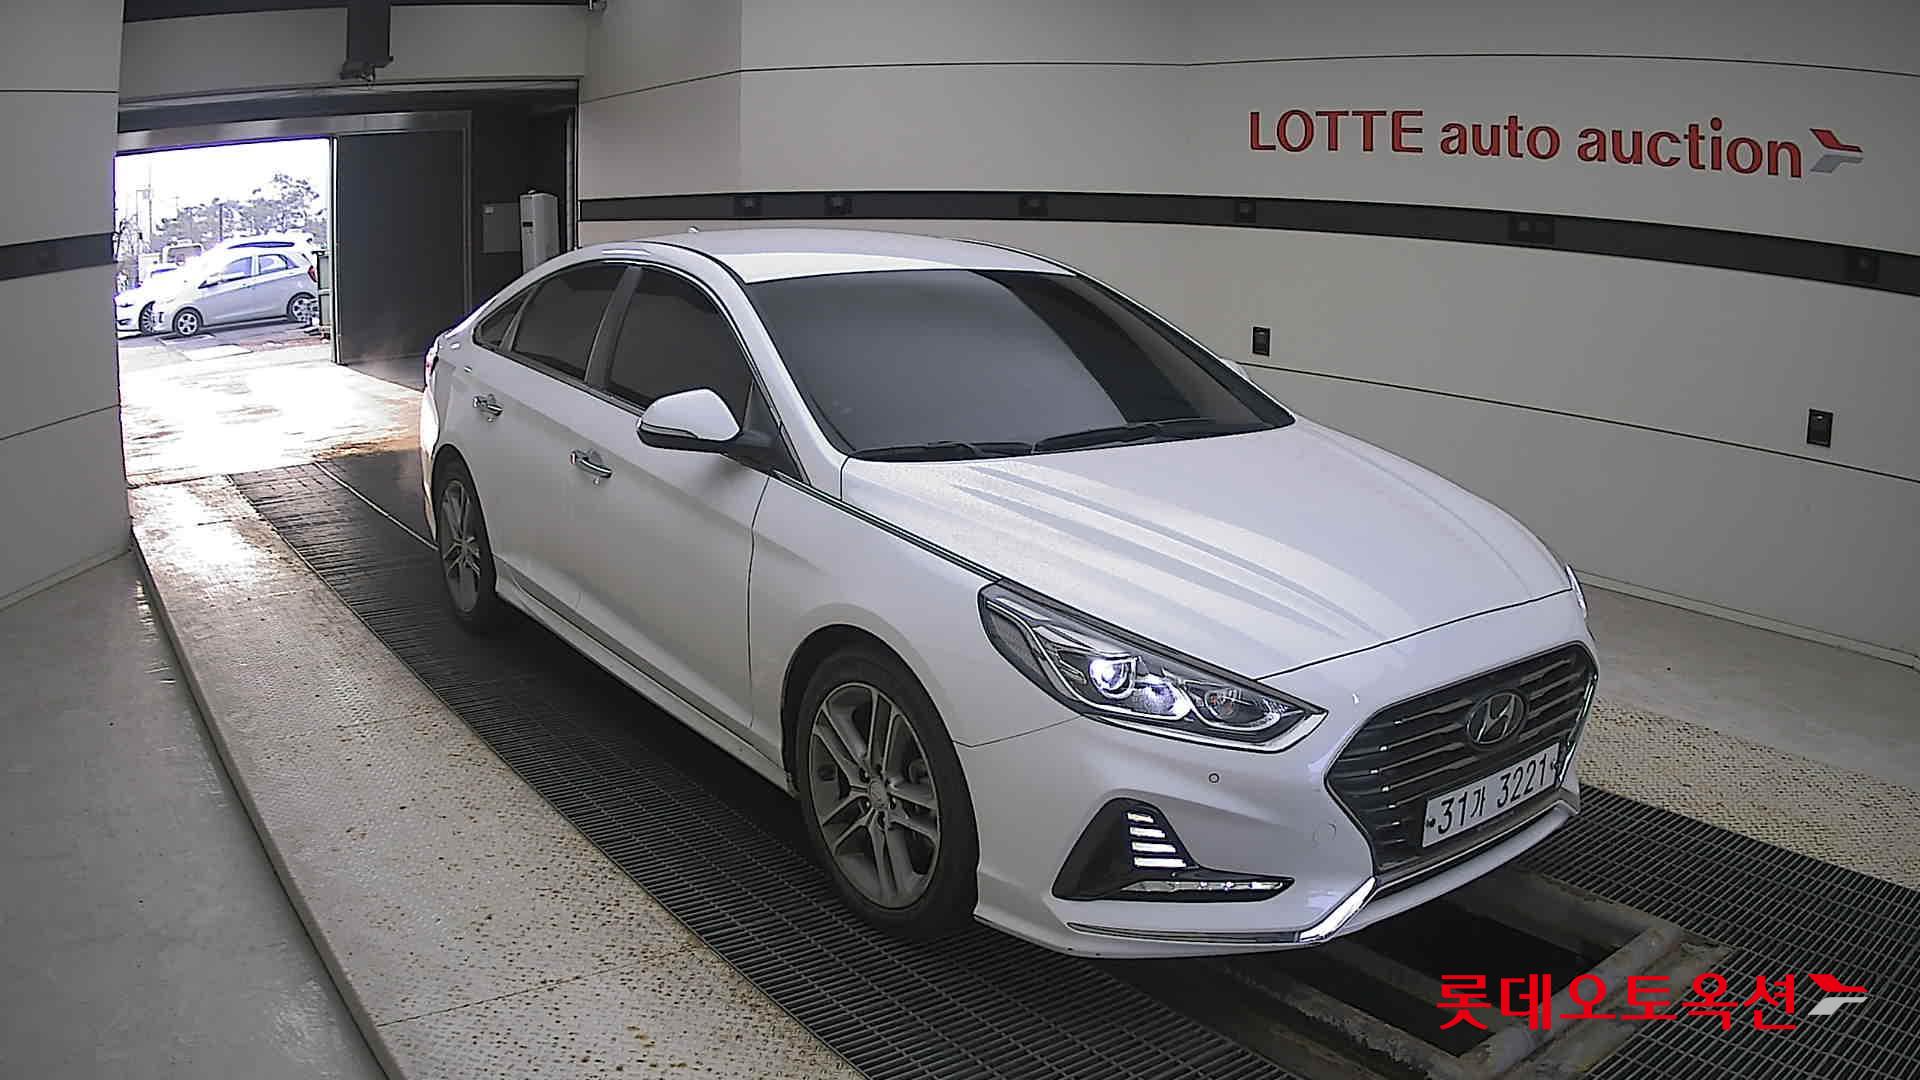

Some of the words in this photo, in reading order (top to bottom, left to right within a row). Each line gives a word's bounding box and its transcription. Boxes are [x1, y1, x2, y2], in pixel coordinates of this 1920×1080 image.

[1249, 110, 1424, 154] LOTTE
[1440, 114, 1561, 161] auto
[1576, 116, 1803, 178] auction
[1438, 787, 1486, 834] 31가
[1497, 753, 1548, 809] 3221
